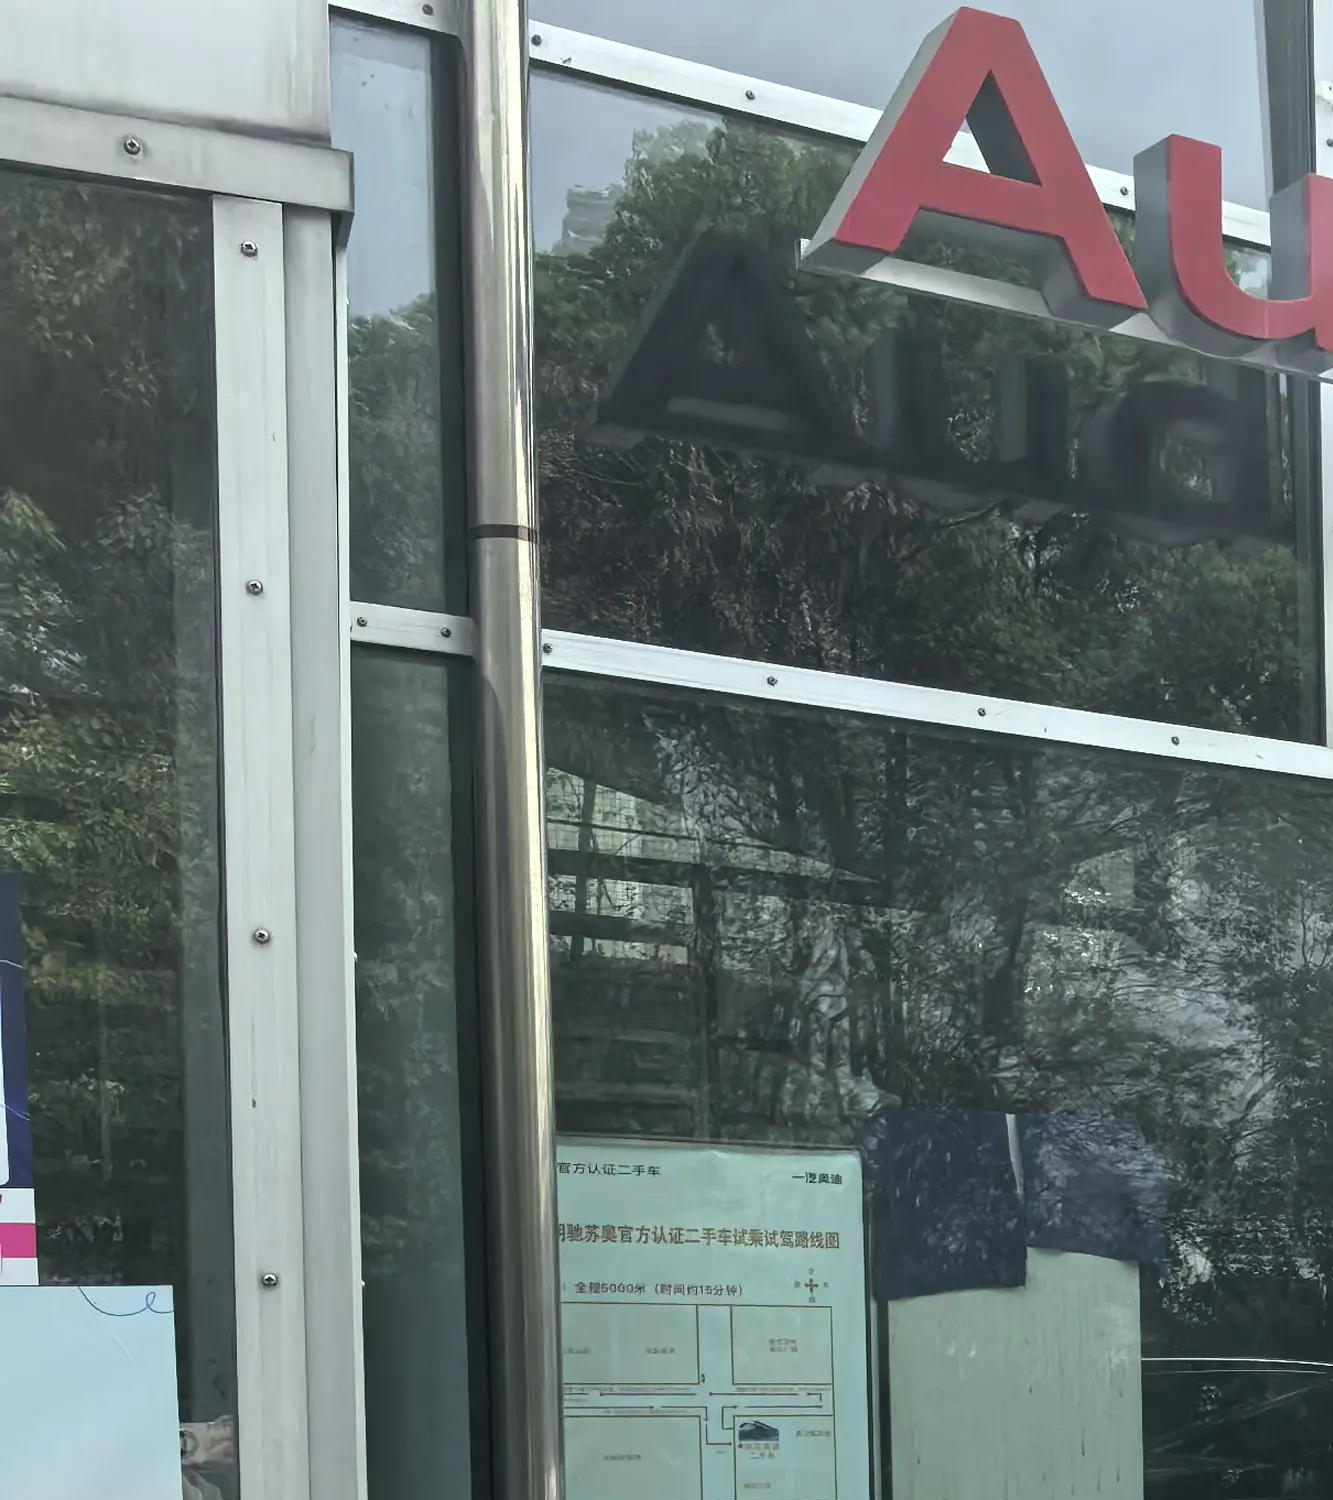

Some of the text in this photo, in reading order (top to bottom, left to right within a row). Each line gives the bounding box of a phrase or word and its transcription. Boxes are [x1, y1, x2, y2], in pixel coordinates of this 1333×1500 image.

[557, 1162, 661, 1177] 官方认证二手车
